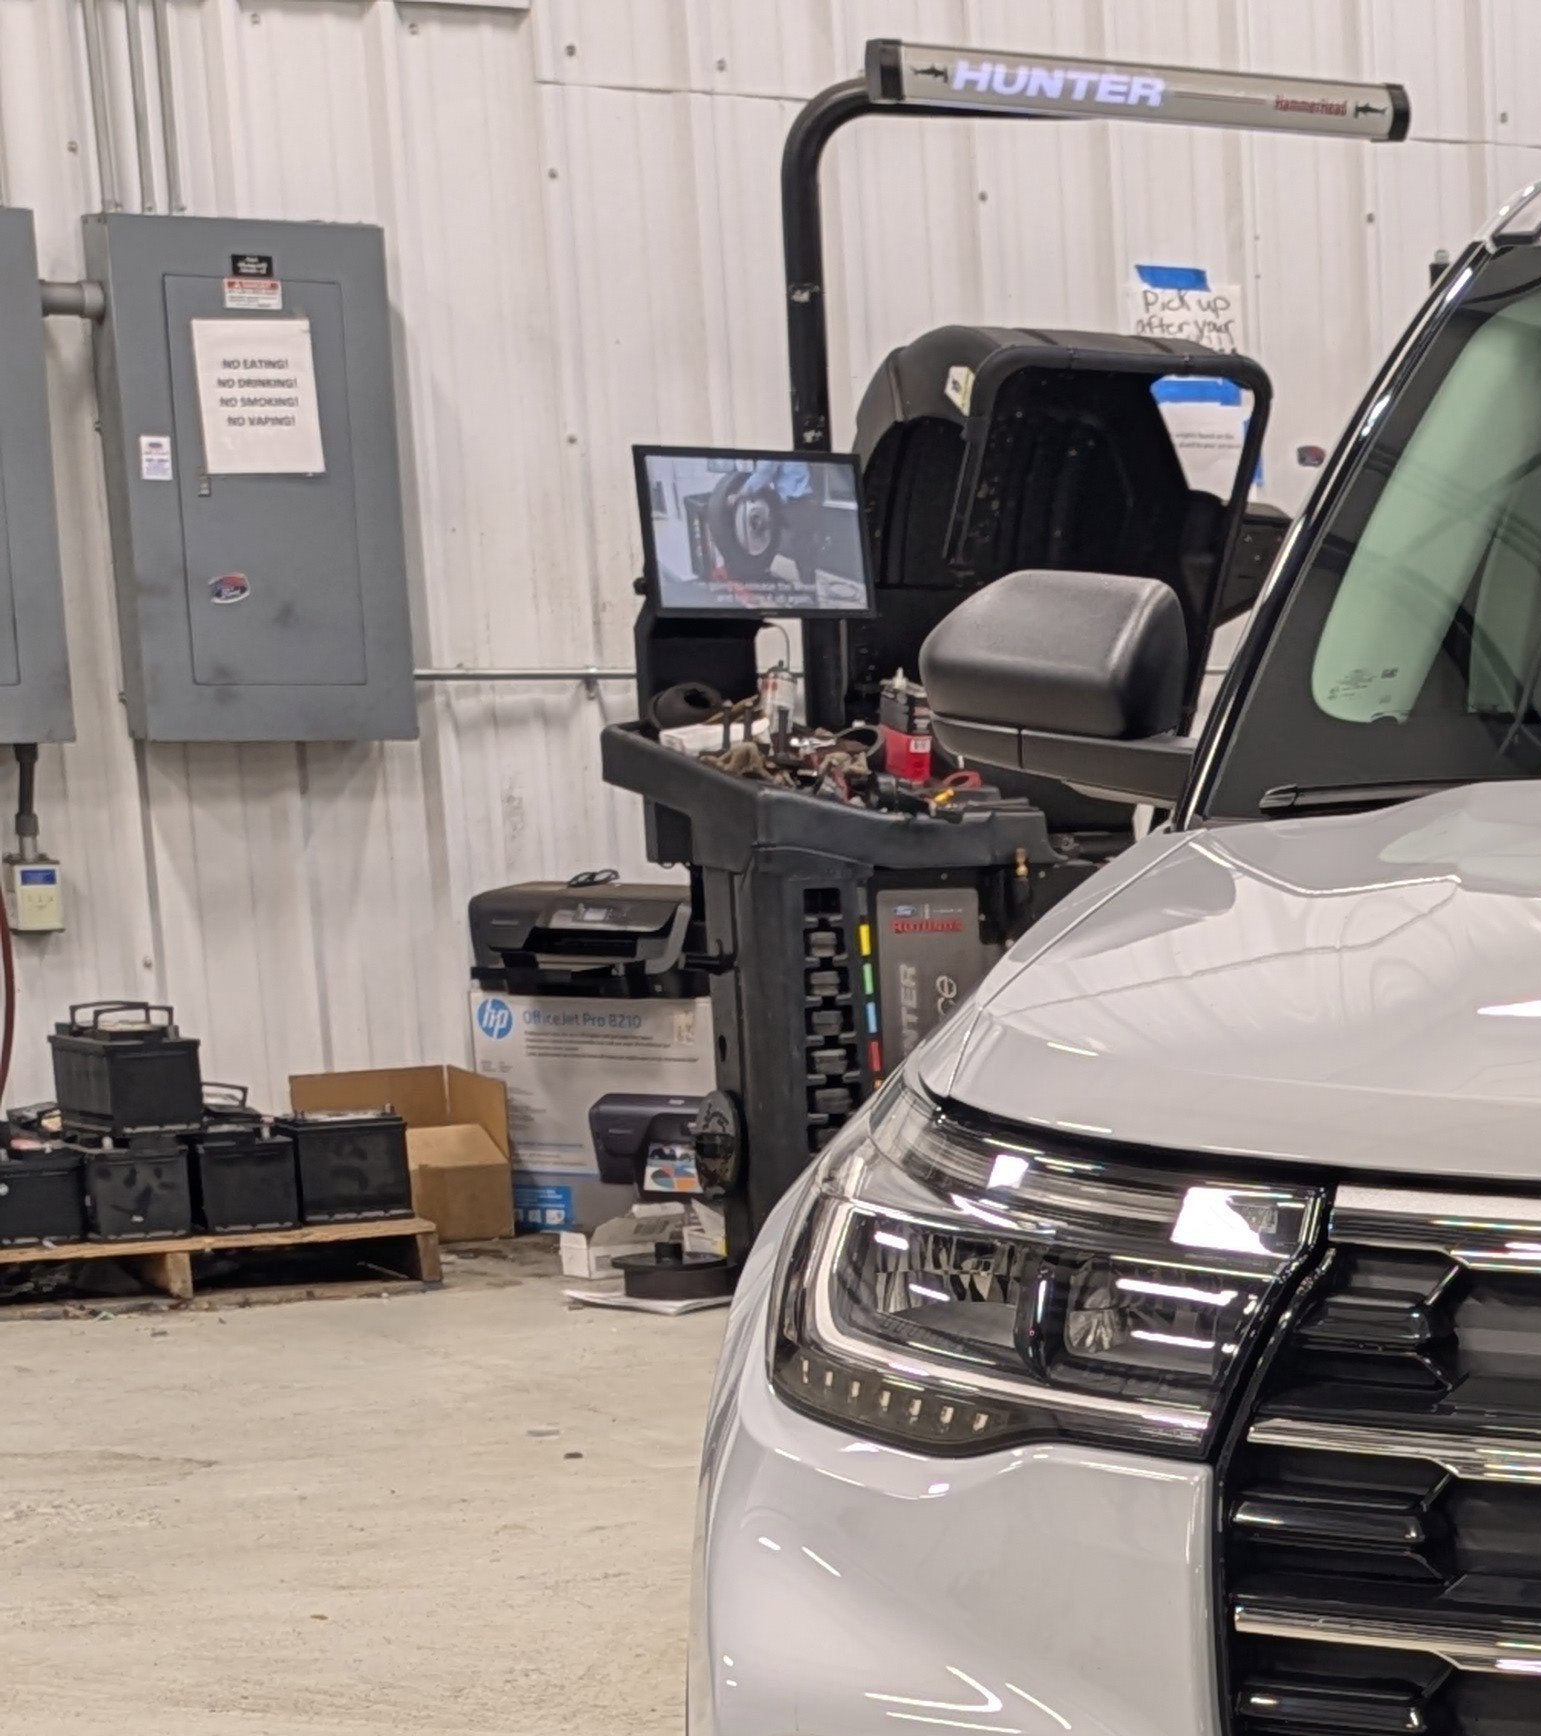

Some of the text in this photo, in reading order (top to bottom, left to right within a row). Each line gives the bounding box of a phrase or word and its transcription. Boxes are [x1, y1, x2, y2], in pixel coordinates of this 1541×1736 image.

[951, 60, 1168, 107] HUNTER
[1273, 95, 1348, 117] Hammerhead
[1142, 287, 1231, 318] Pick up
[1136, 315, 1235, 343] after your
[222, 358, 289, 370] NO EATING!
[217, 377, 298, 389] NO DRINKING!
[220, 396, 299, 408] NO SMOKING!
[227, 415, 296, 427] NO VAPING!
[483, 998, 508, 1040] hp
[522, 1010, 642, 1029] OfficeJet Pro 8210
[899, 963, 919, 1055] NTER
